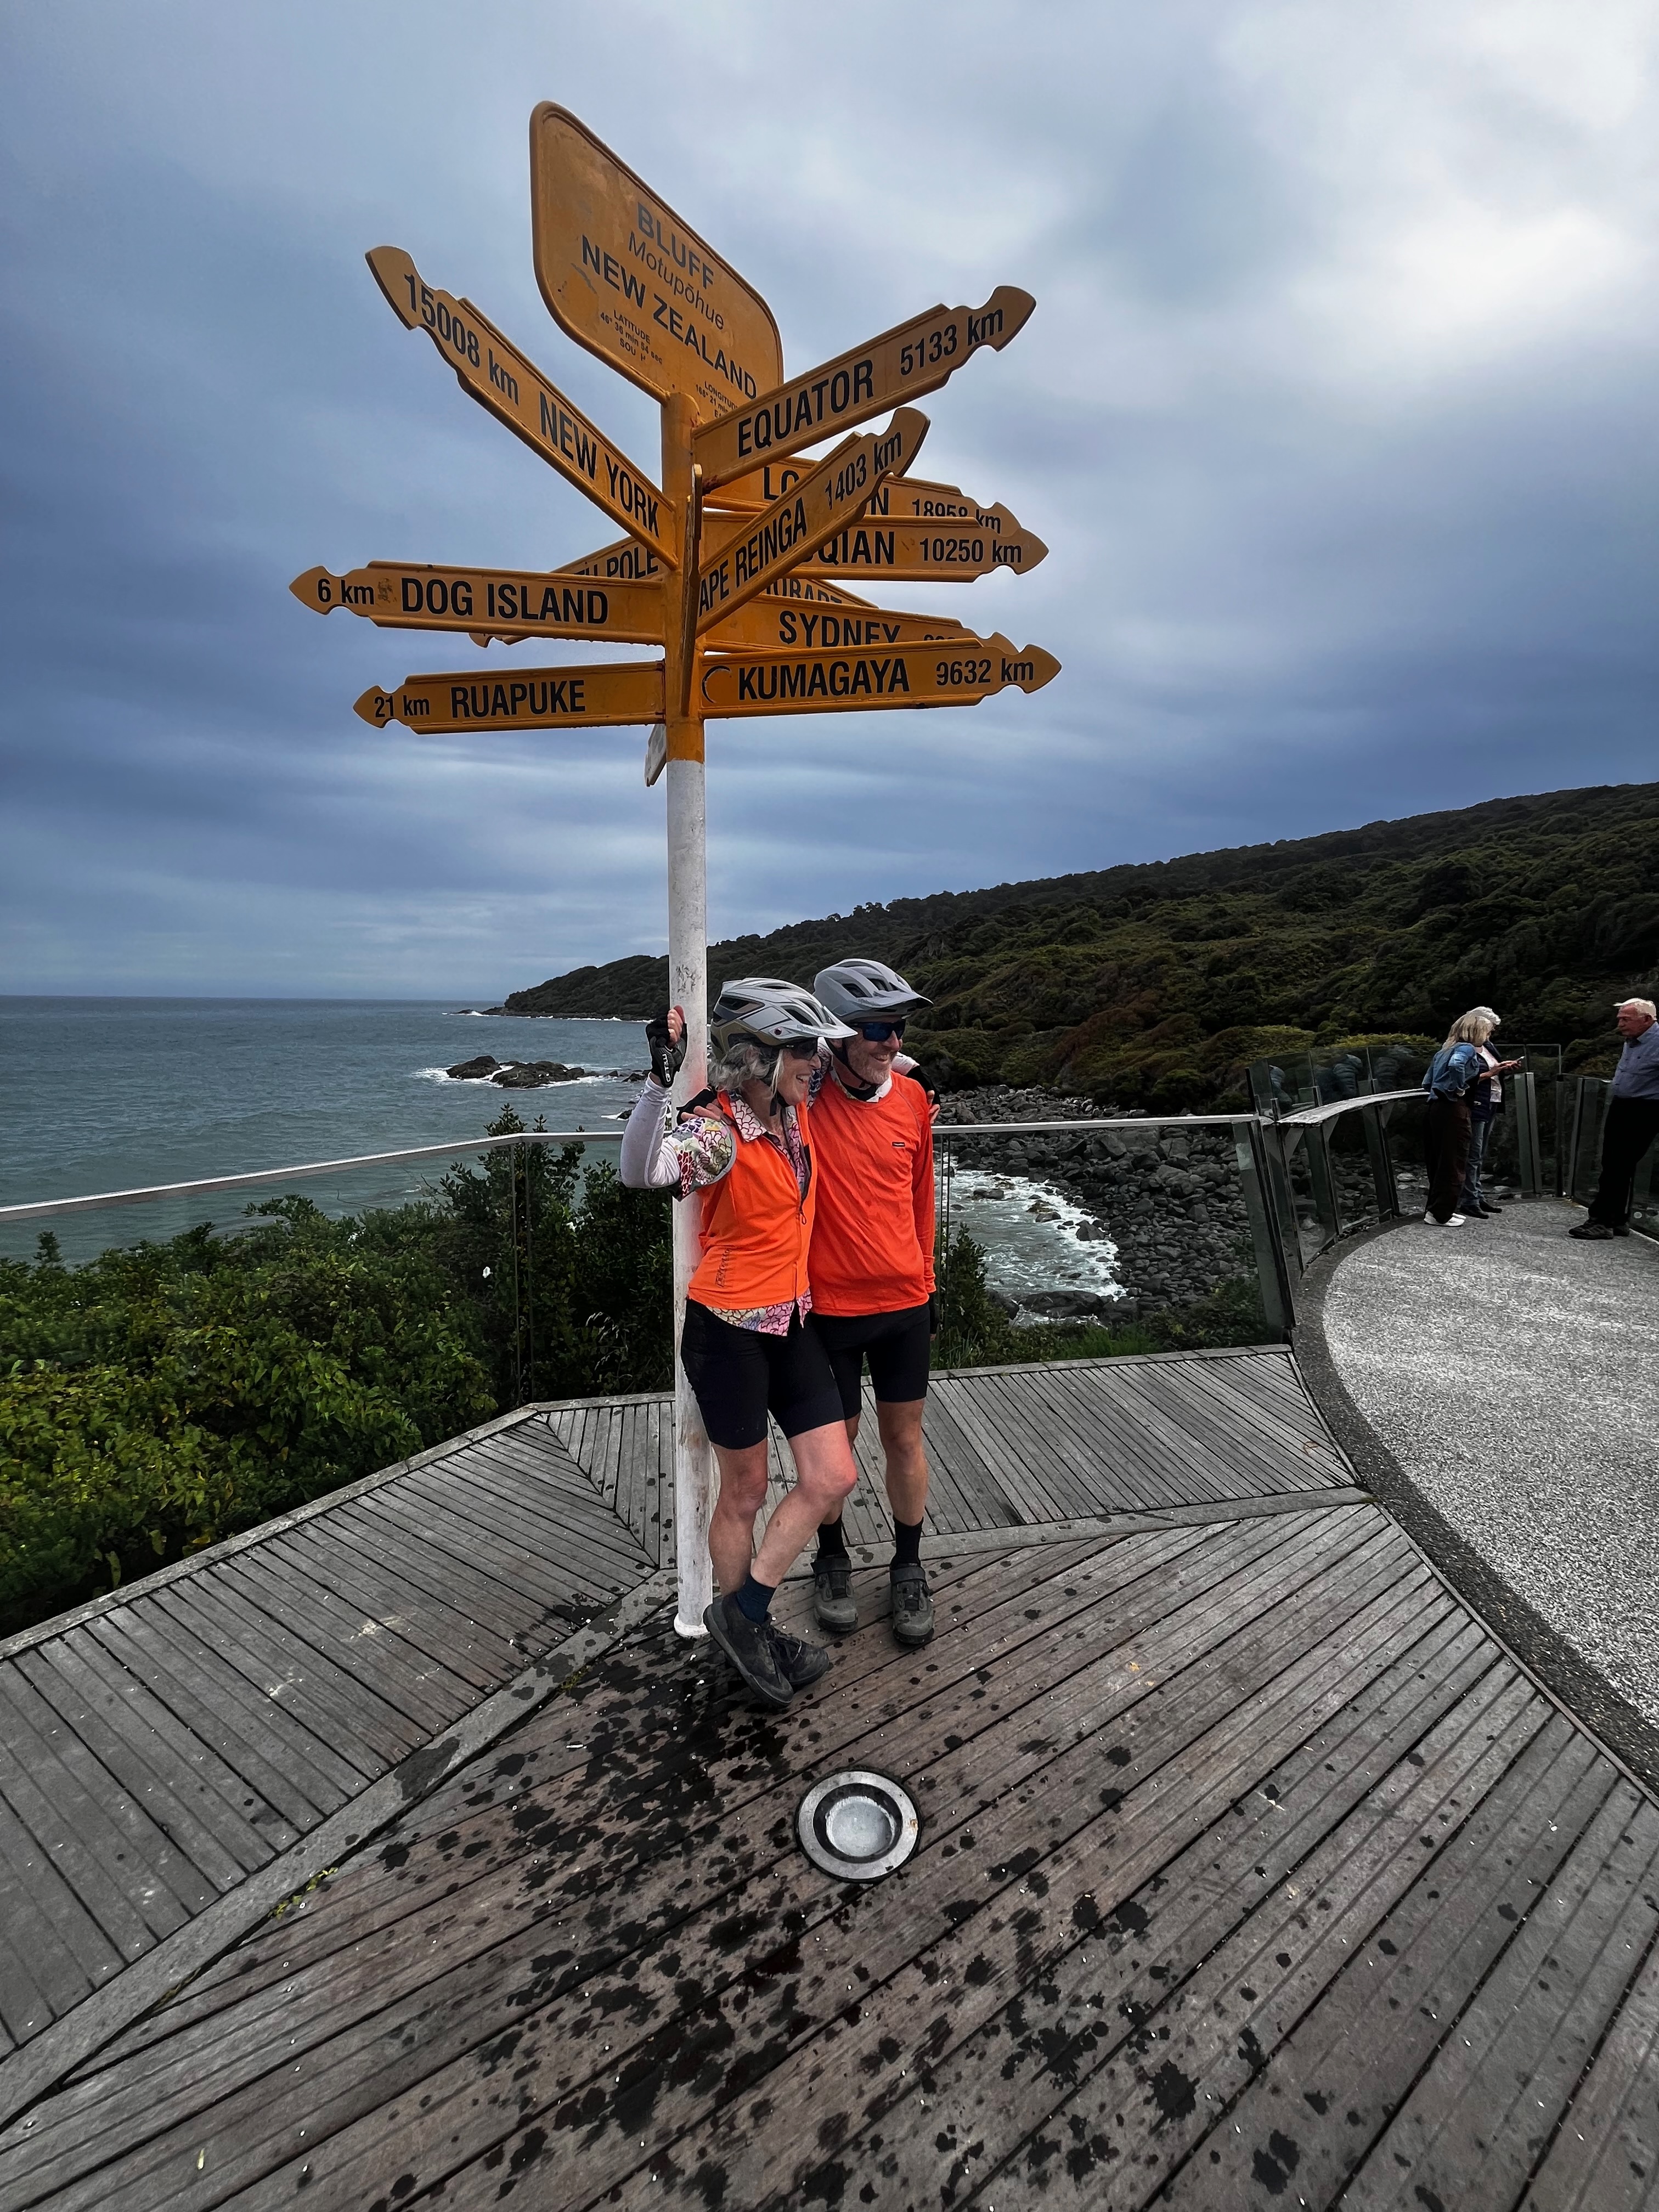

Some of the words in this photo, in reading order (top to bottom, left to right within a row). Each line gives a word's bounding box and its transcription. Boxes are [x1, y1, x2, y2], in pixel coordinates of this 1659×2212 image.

[637, 201, 715, 290] BLUFF
[628, 230, 725, 330] Motupōhue
[582, 234, 647, 308] NEW
[653, 295, 758, 400] ZEALAND
[614, 309, 651, 345] LATITUDE
[625, 331, 639, 347] min
[403, 273, 480, 368] 15008
[487, 348, 520, 405] km
[538, 391, 597, 481] NEW
[605, 454, 659, 538] YORK
[704, 380, 738, 410] LONGITUD
[738, 359, 874, 459] EQUATOR
[900, 325, 958, 376] 5133
[967, 308, 1003, 347] km
[698, 558, 730, 618] APE
[736, 497, 807, 588] REINGA
[825, 454, 867, 511] 1403
[874, 431, 902, 475] km
[606, 546, 659, 579] POLE
[802, 529, 895, 566] QIAN
[919, 538, 984, 563] 10250
[992, 540, 1022, 563] km
[318, 578, 332, 603] 6
[340, 584, 375, 606] km
[401, 577, 473, 617] DOG
[487, 582, 609, 624] ISLAND
[779, 610, 901, 647] SYDNEY
[374, 695, 396, 718] 21
[403, 694, 430, 717] km
[450, 679, 586, 718] RUAPUKE
[738, 658, 910, 701] KUMAGAYA
[935, 659, 991, 686] 9632
[1001, 656, 1034, 683] km
